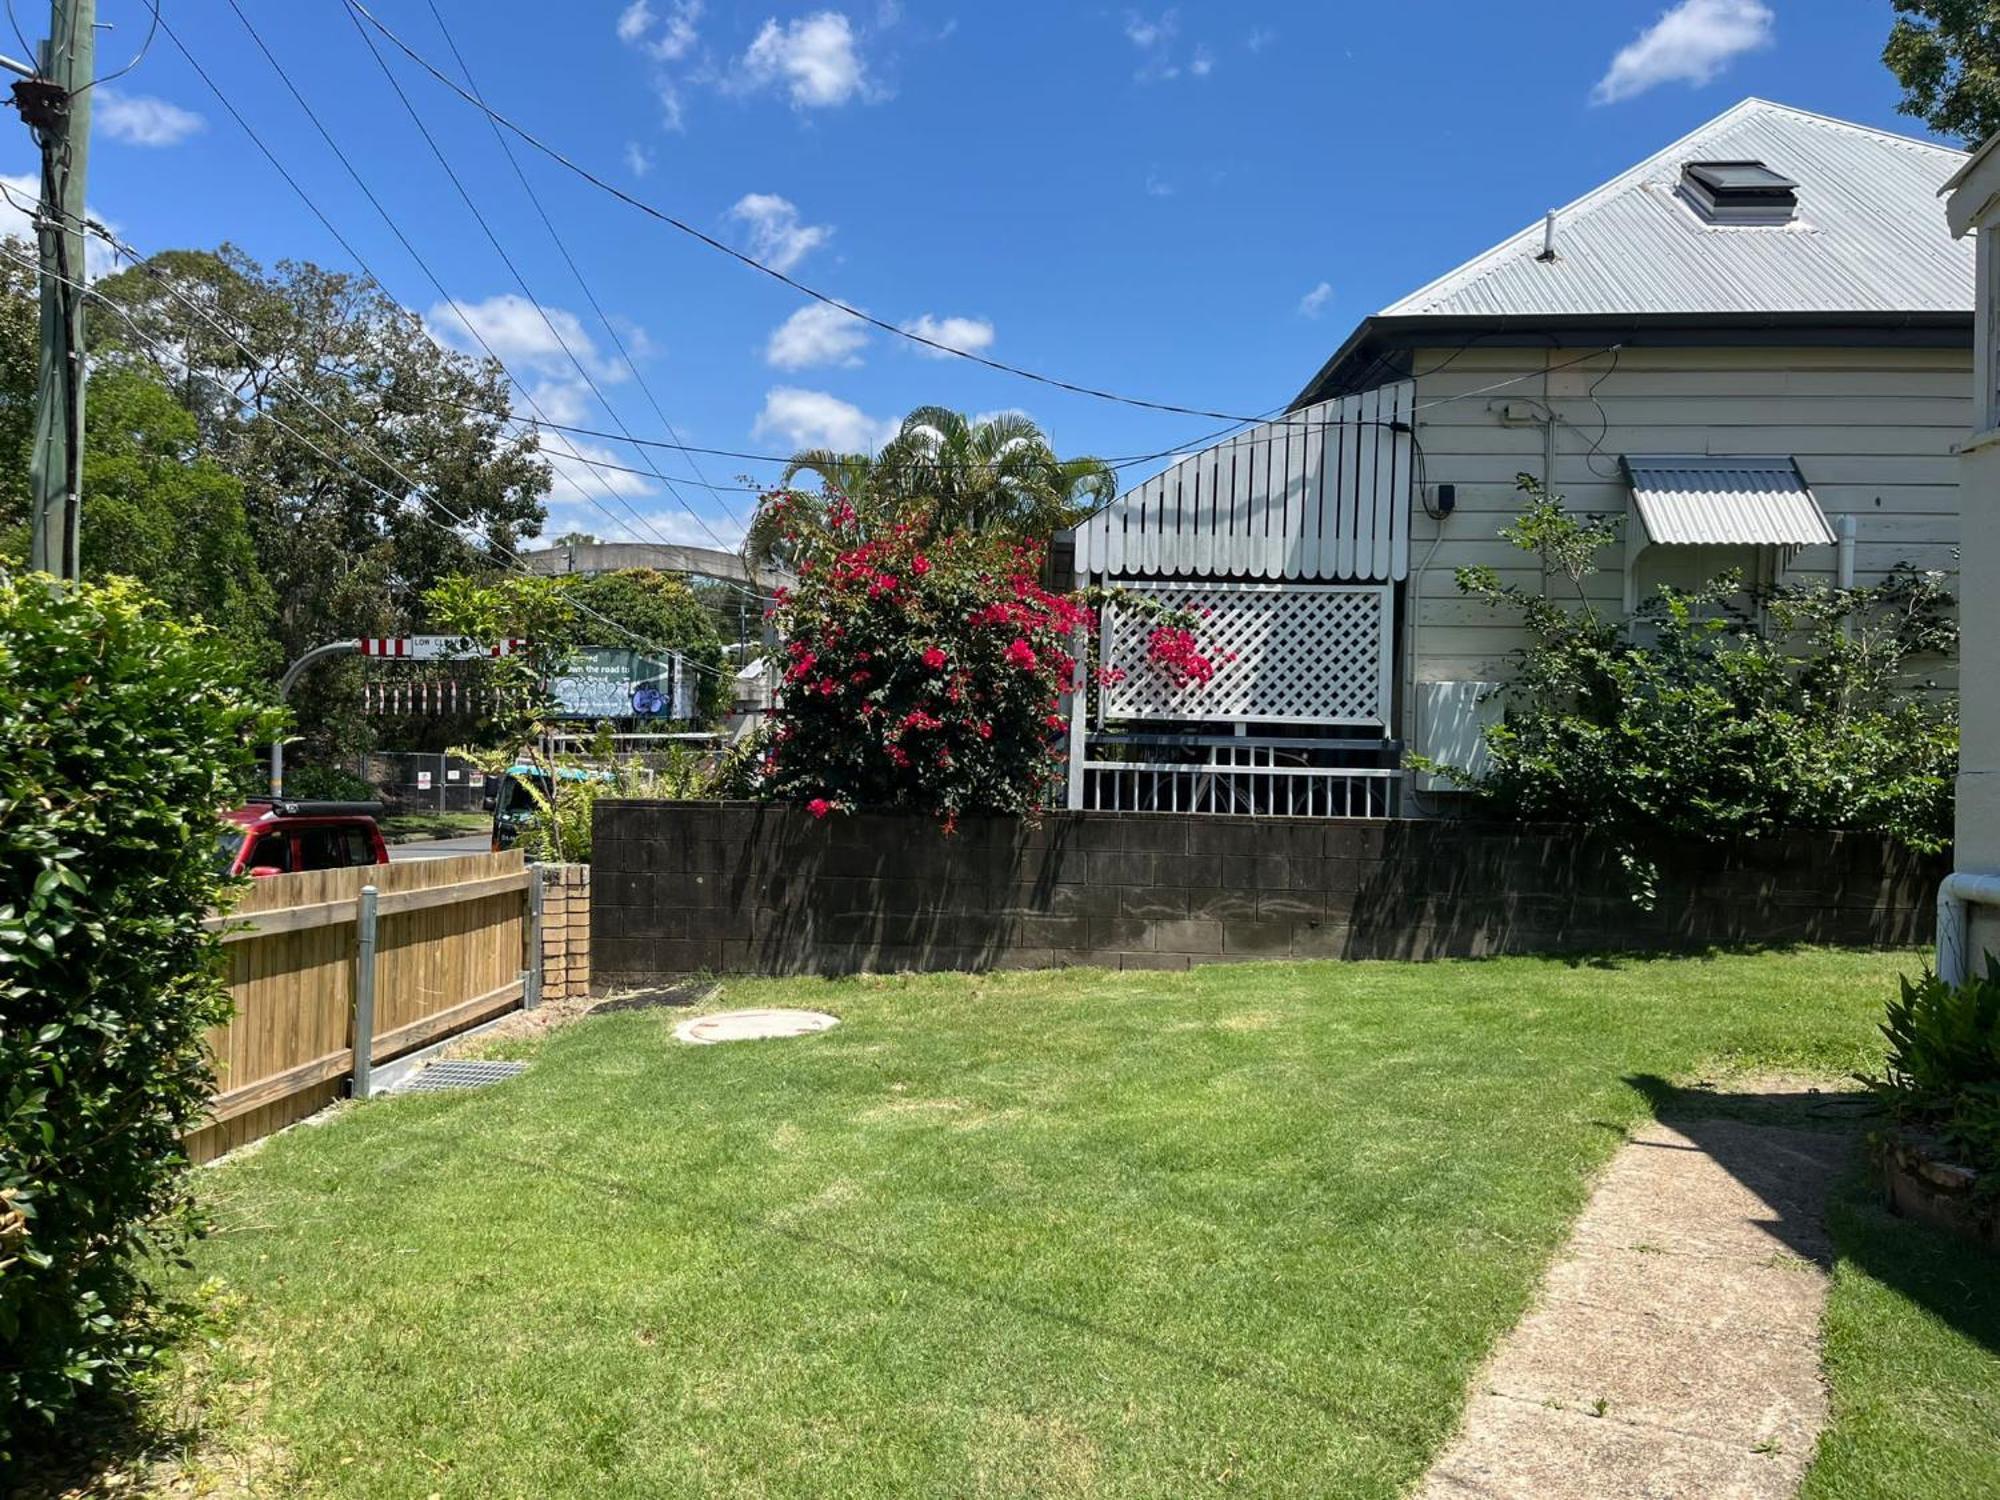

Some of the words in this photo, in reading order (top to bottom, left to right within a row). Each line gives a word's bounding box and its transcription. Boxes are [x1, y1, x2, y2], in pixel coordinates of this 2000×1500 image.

[414, 639, 430, 647] LOW
[585, 664, 599, 673] the
[600, 664, 620, 673] road
[621, 664, 630, 673] to
